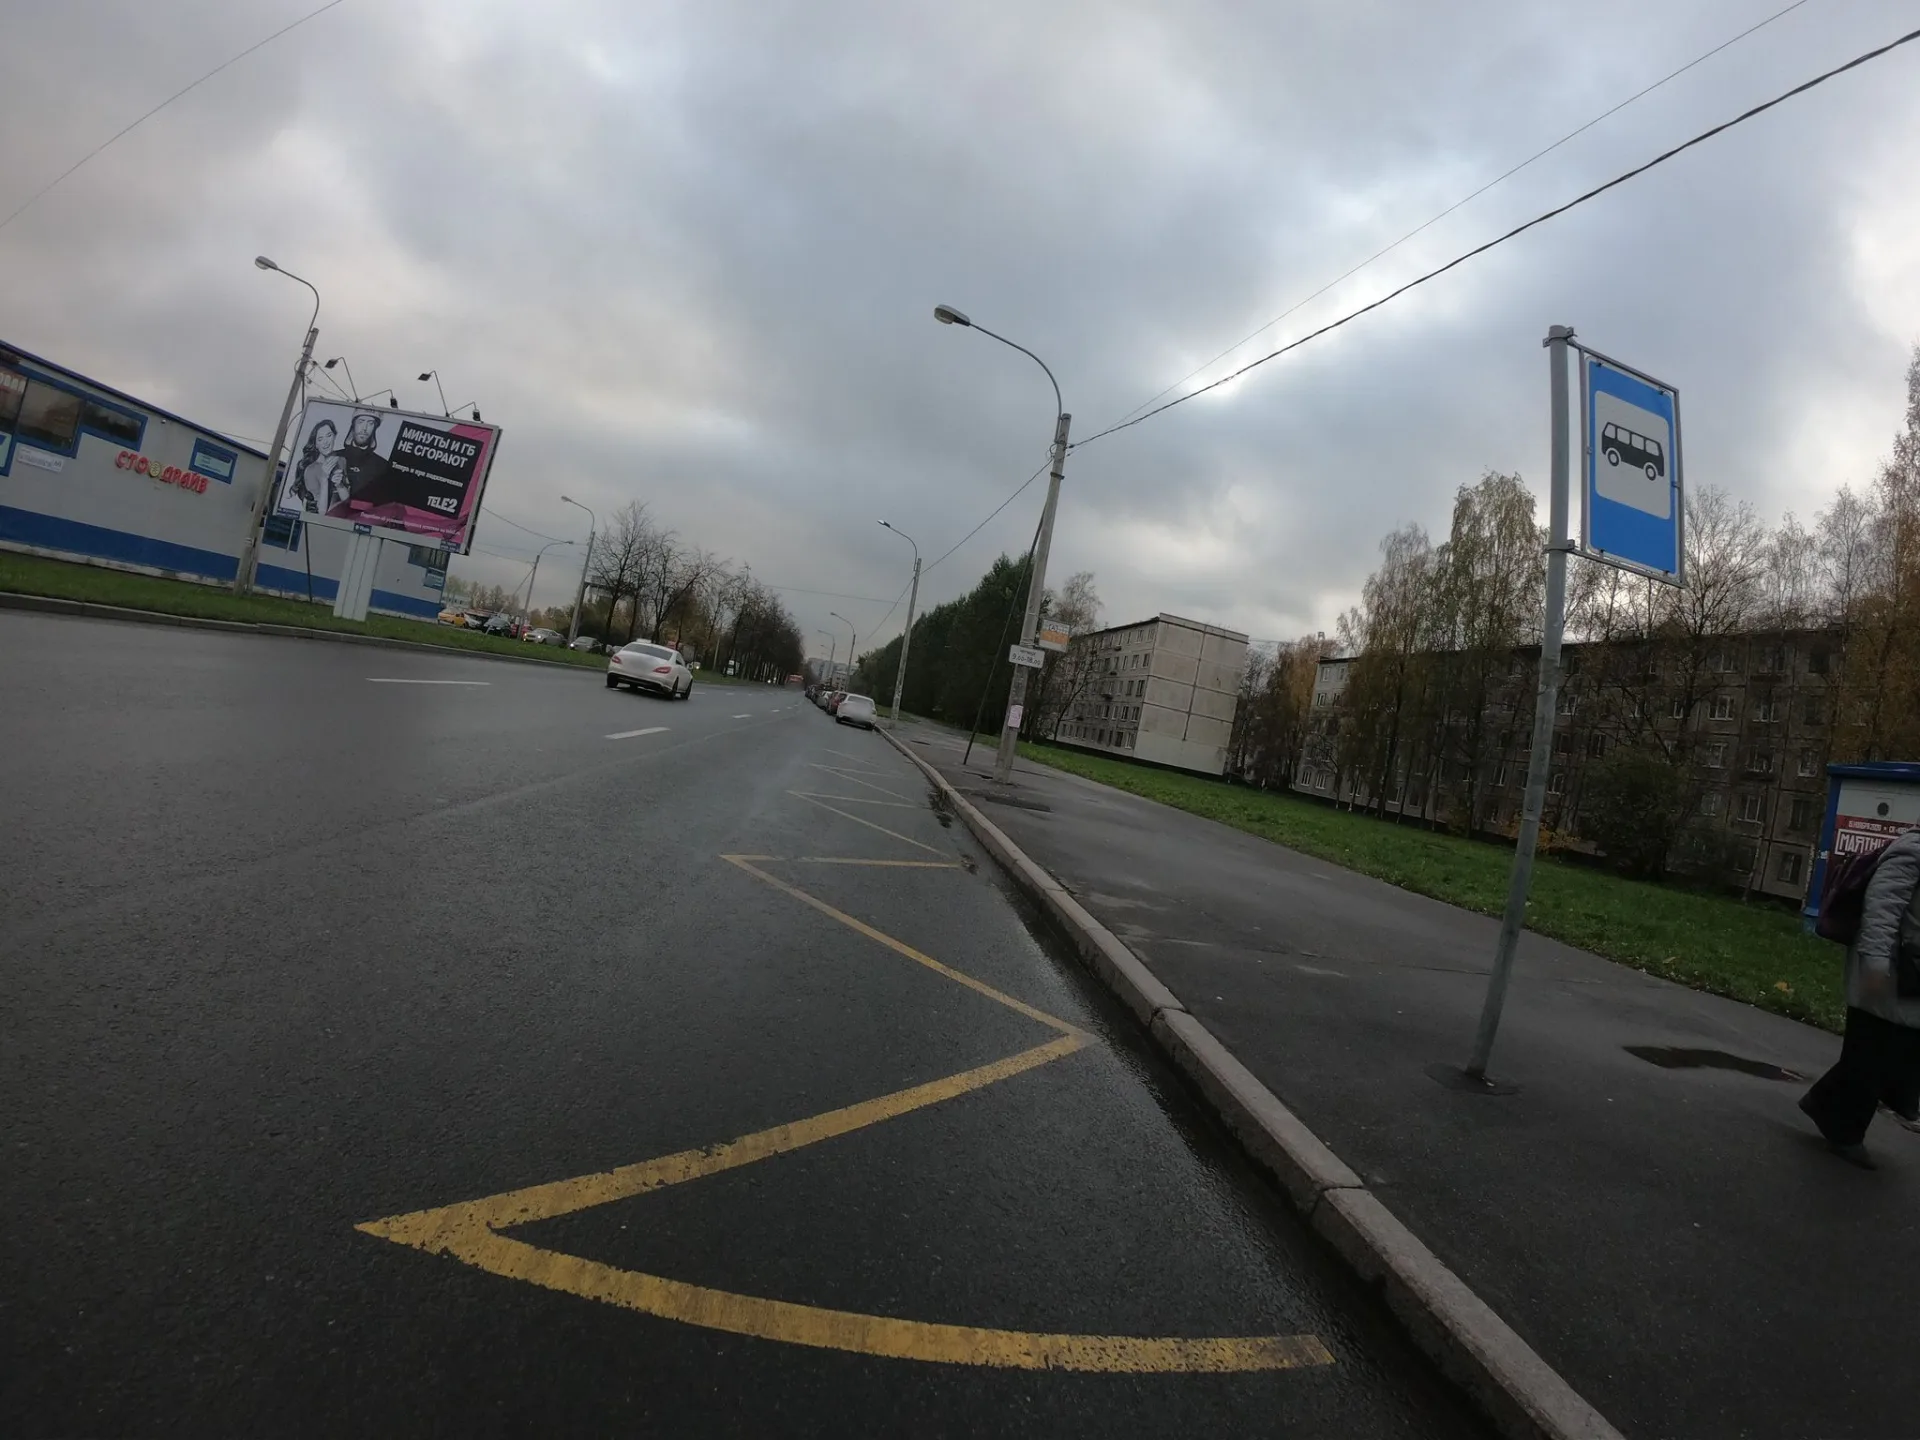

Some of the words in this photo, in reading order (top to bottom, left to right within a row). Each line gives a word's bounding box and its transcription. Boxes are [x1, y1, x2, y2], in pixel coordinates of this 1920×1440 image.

[397, 440, 413, 453] НЕ
[414, 445, 468, 468] СГОРАЮТ
[402, 427, 450, 449] МИНУТЫ
[450, 441, 460, 452] И
[460, 443, 475, 456] ГБ
[115, 450, 149, 474] СТО
[427, 495, 458, 513] TELE2
